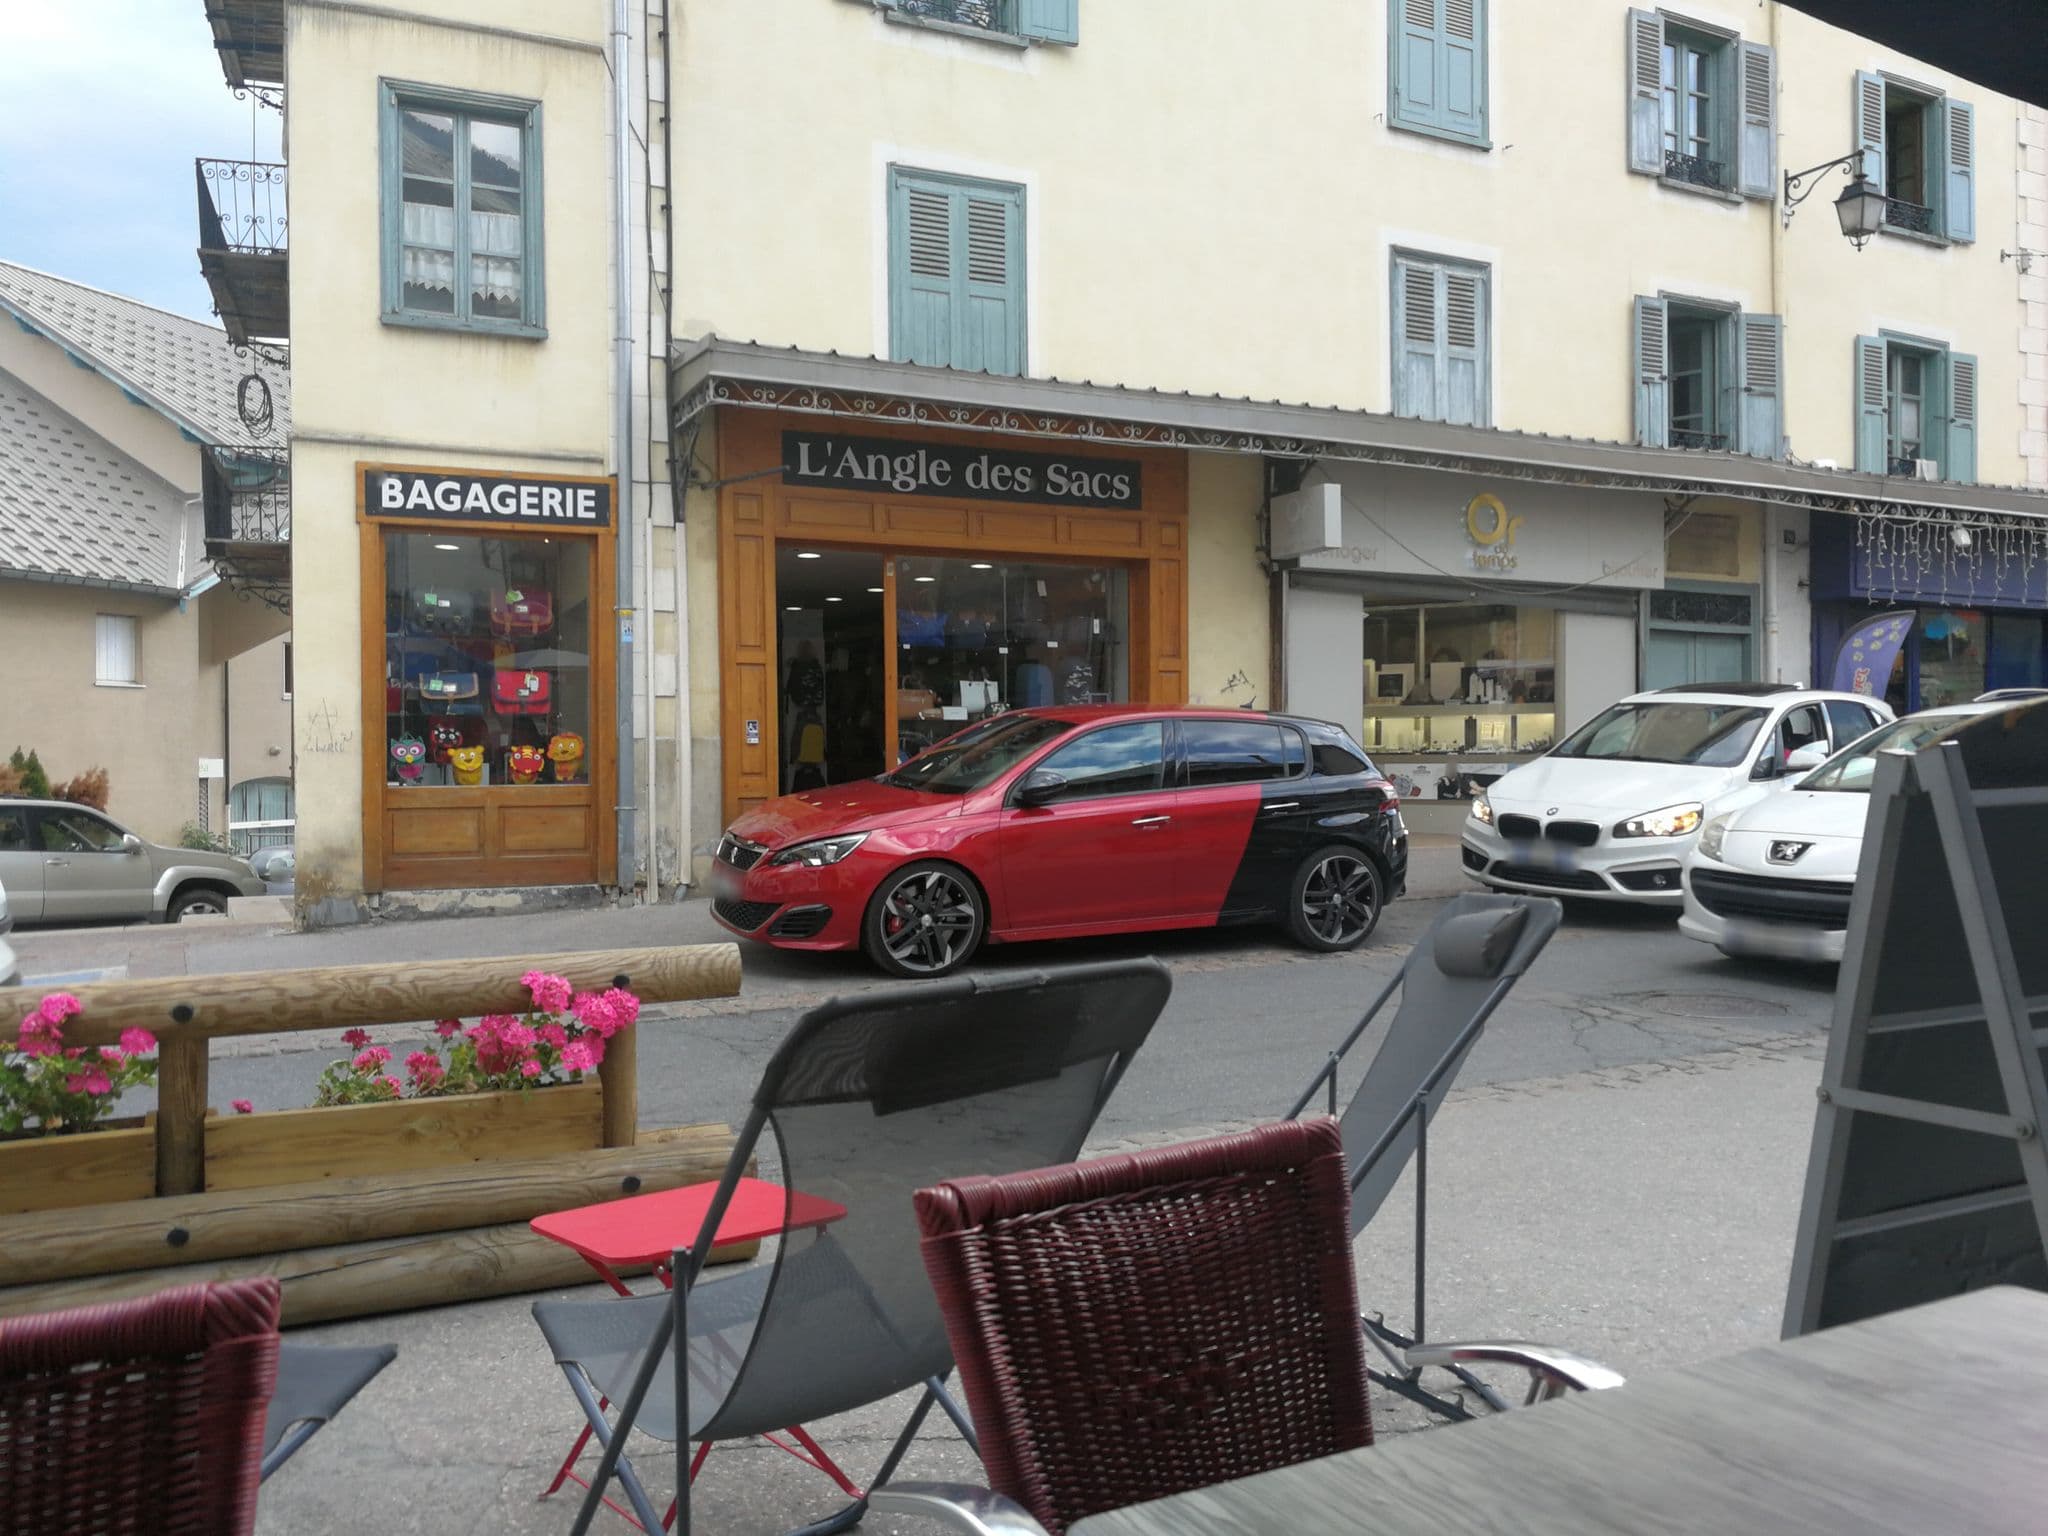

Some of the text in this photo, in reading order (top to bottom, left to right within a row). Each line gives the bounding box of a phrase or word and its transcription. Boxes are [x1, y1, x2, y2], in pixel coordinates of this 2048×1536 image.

[797, 441, 1131, 500] L'Angle des Sacs
[381, 478, 596, 519] BAGAGERIE
[1467, 493, 1526, 545] Or
[1473, 551, 1517, 571] temps
